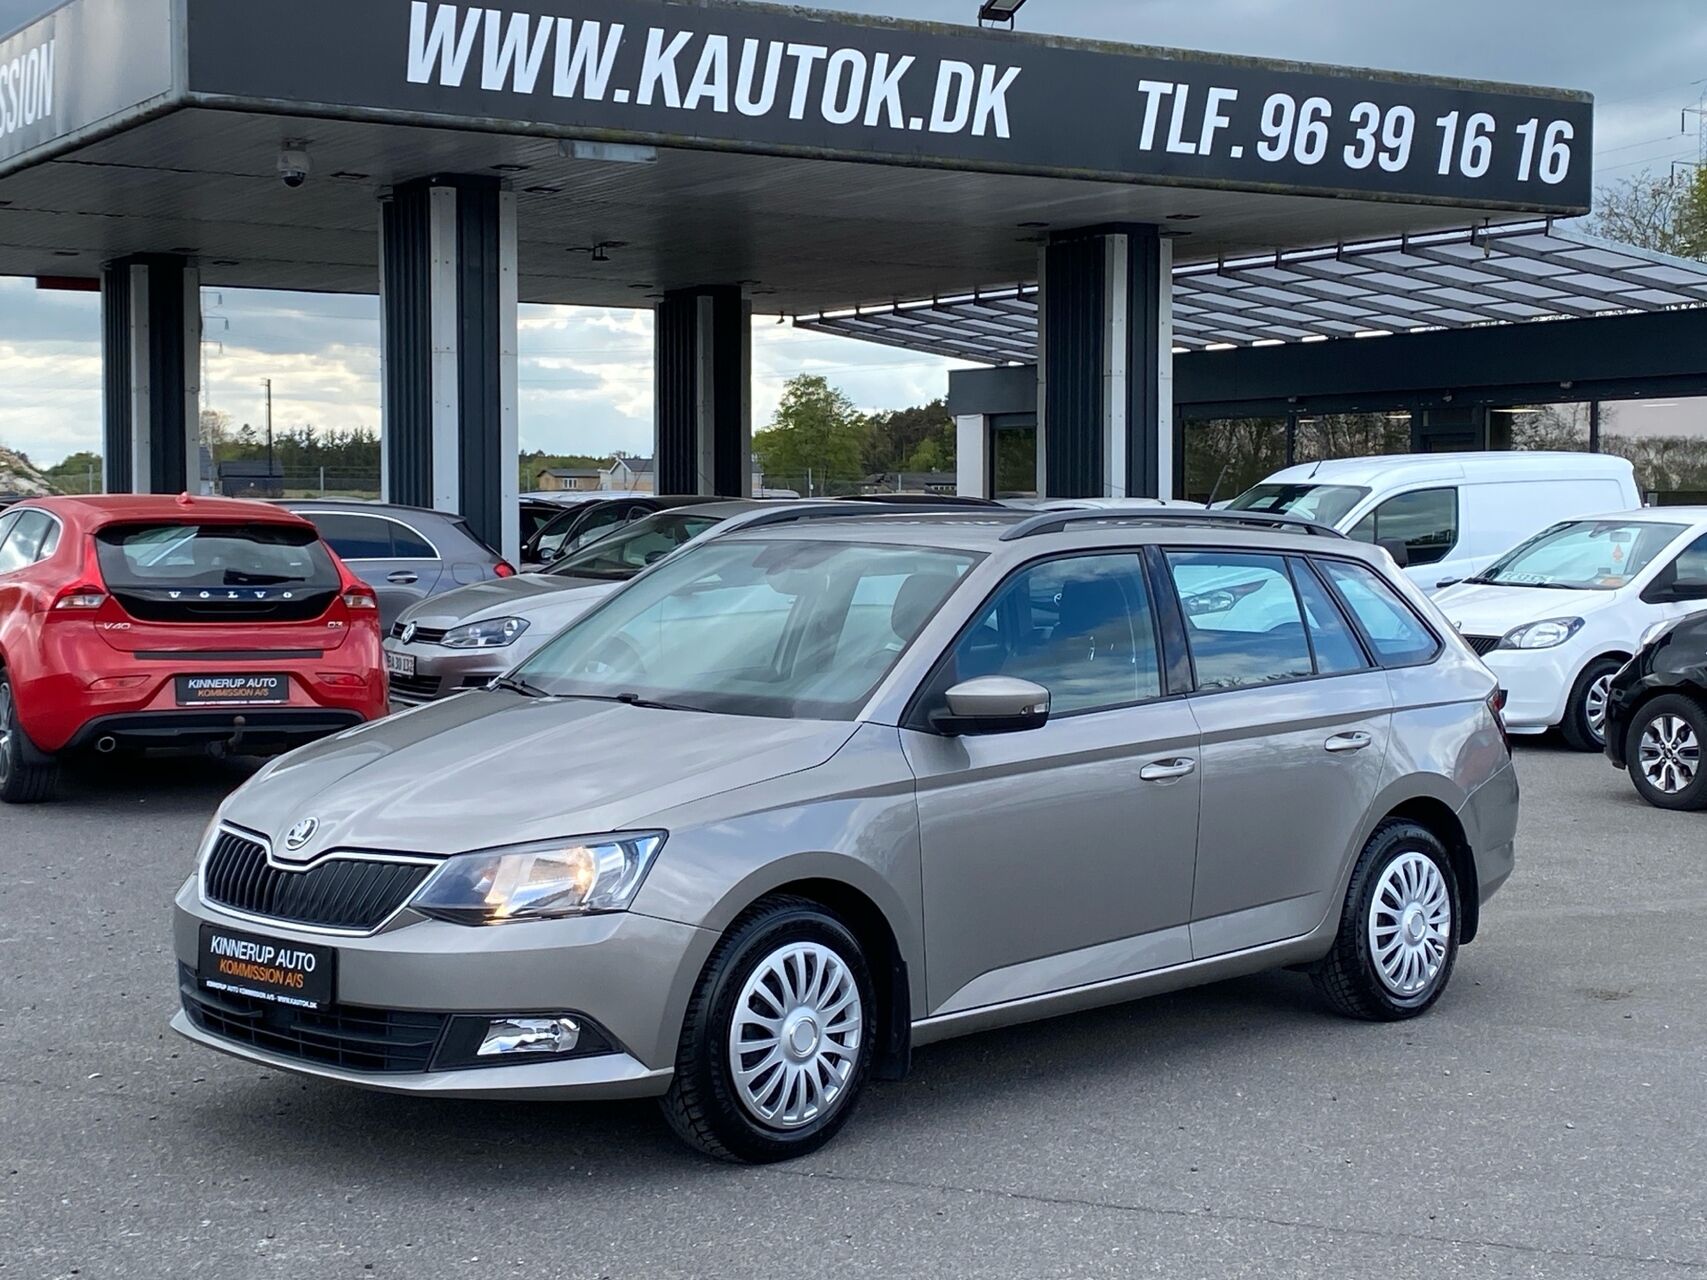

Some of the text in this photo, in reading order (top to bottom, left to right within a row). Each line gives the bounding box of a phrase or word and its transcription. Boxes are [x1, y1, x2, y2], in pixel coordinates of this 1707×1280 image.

[406, 1, 1022, 138] WWW.KAUTOK.DK
[1137, 79, 1575, 185] TLF. 96 39 16 16
[168, 591, 293, 599] VOLVO
[103, 622, 131, 630] V40
[188, 677, 278, 689] KINNERUP AUTO
[198, 688, 270, 697] KOMMISSION A/S
[210, 935, 316, 973] KINNERUP AUTO
[219, 958, 304, 989] KOMMISSION A/S
